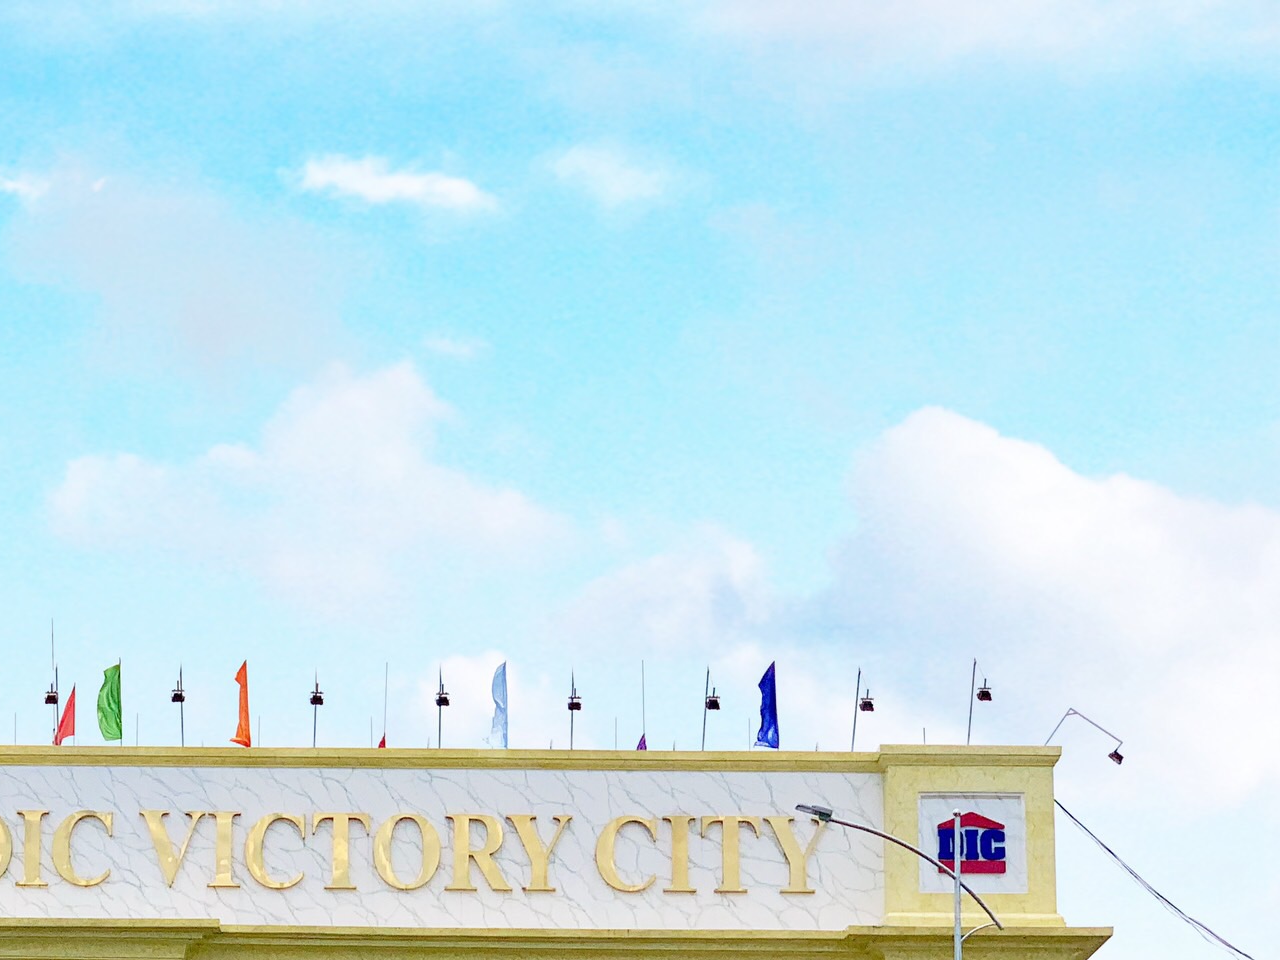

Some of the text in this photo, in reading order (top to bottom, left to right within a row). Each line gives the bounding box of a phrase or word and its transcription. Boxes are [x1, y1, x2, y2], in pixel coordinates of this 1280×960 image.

[139, 811, 572, 893] VICTORY
[594, 814, 828, 895] CITY
[938, 829, 1006, 860] DIC
